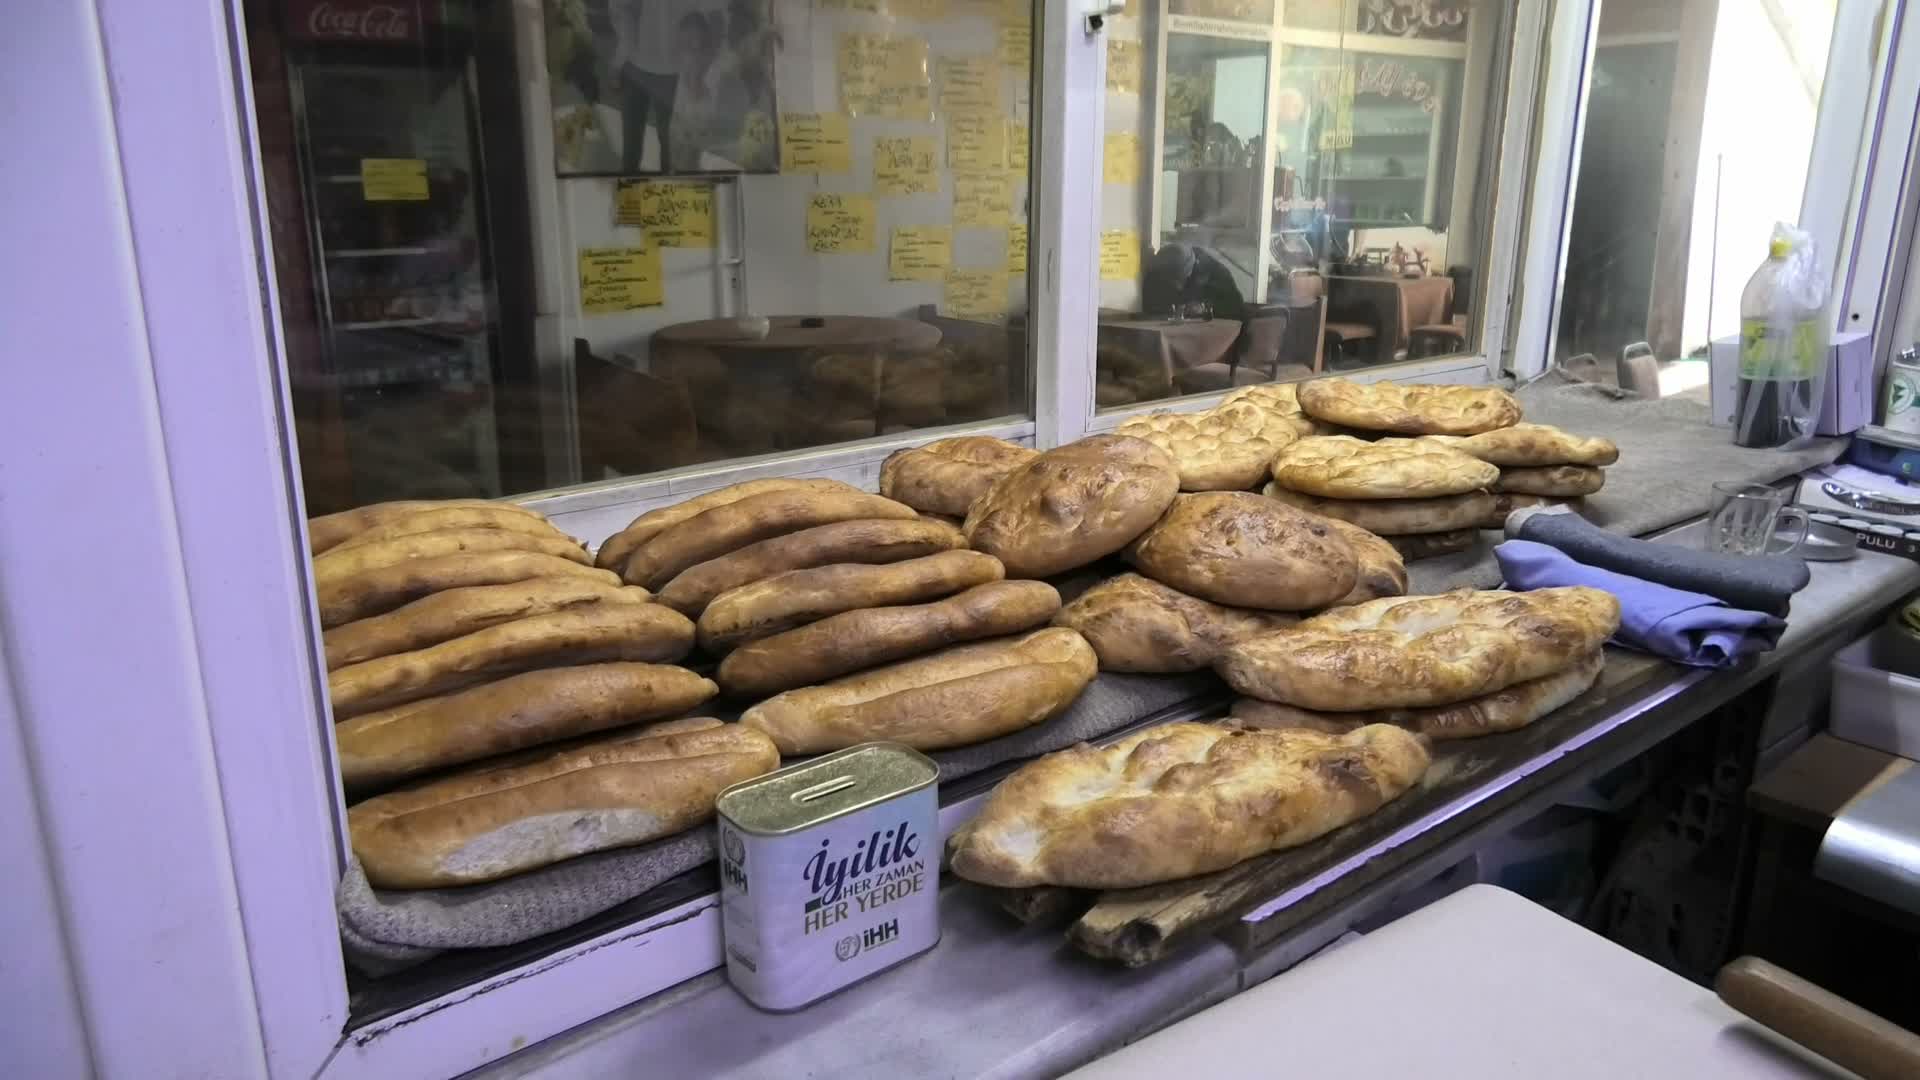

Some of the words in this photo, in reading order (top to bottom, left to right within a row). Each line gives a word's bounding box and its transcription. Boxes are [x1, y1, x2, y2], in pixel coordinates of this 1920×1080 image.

[803, 821, 920, 906] İyilik
[842, 878, 873, 899] HER
[876, 858, 925, 887] ZAMAN
[804, 901, 849, 936] HER
[856, 873, 925, 913] YERDE
